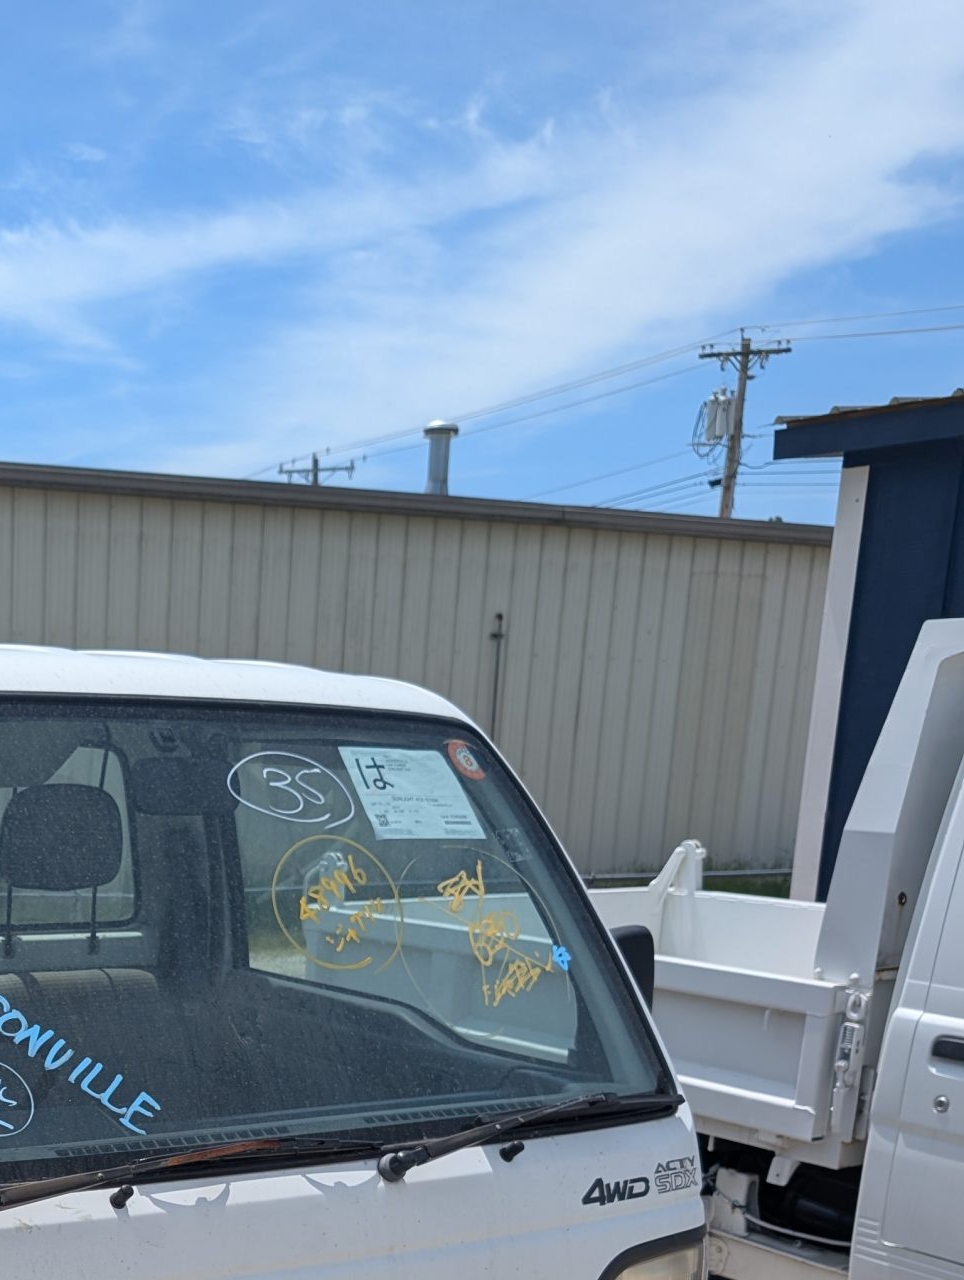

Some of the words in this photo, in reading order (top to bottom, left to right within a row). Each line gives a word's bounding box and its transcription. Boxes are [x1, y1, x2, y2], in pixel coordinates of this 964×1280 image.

[355, 757, 395, 791] は
[654, 1155, 696, 1174] ACTY
[581, 1176, 651, 1206] 4WD
[654, 1167, 698, 1194] SDX
